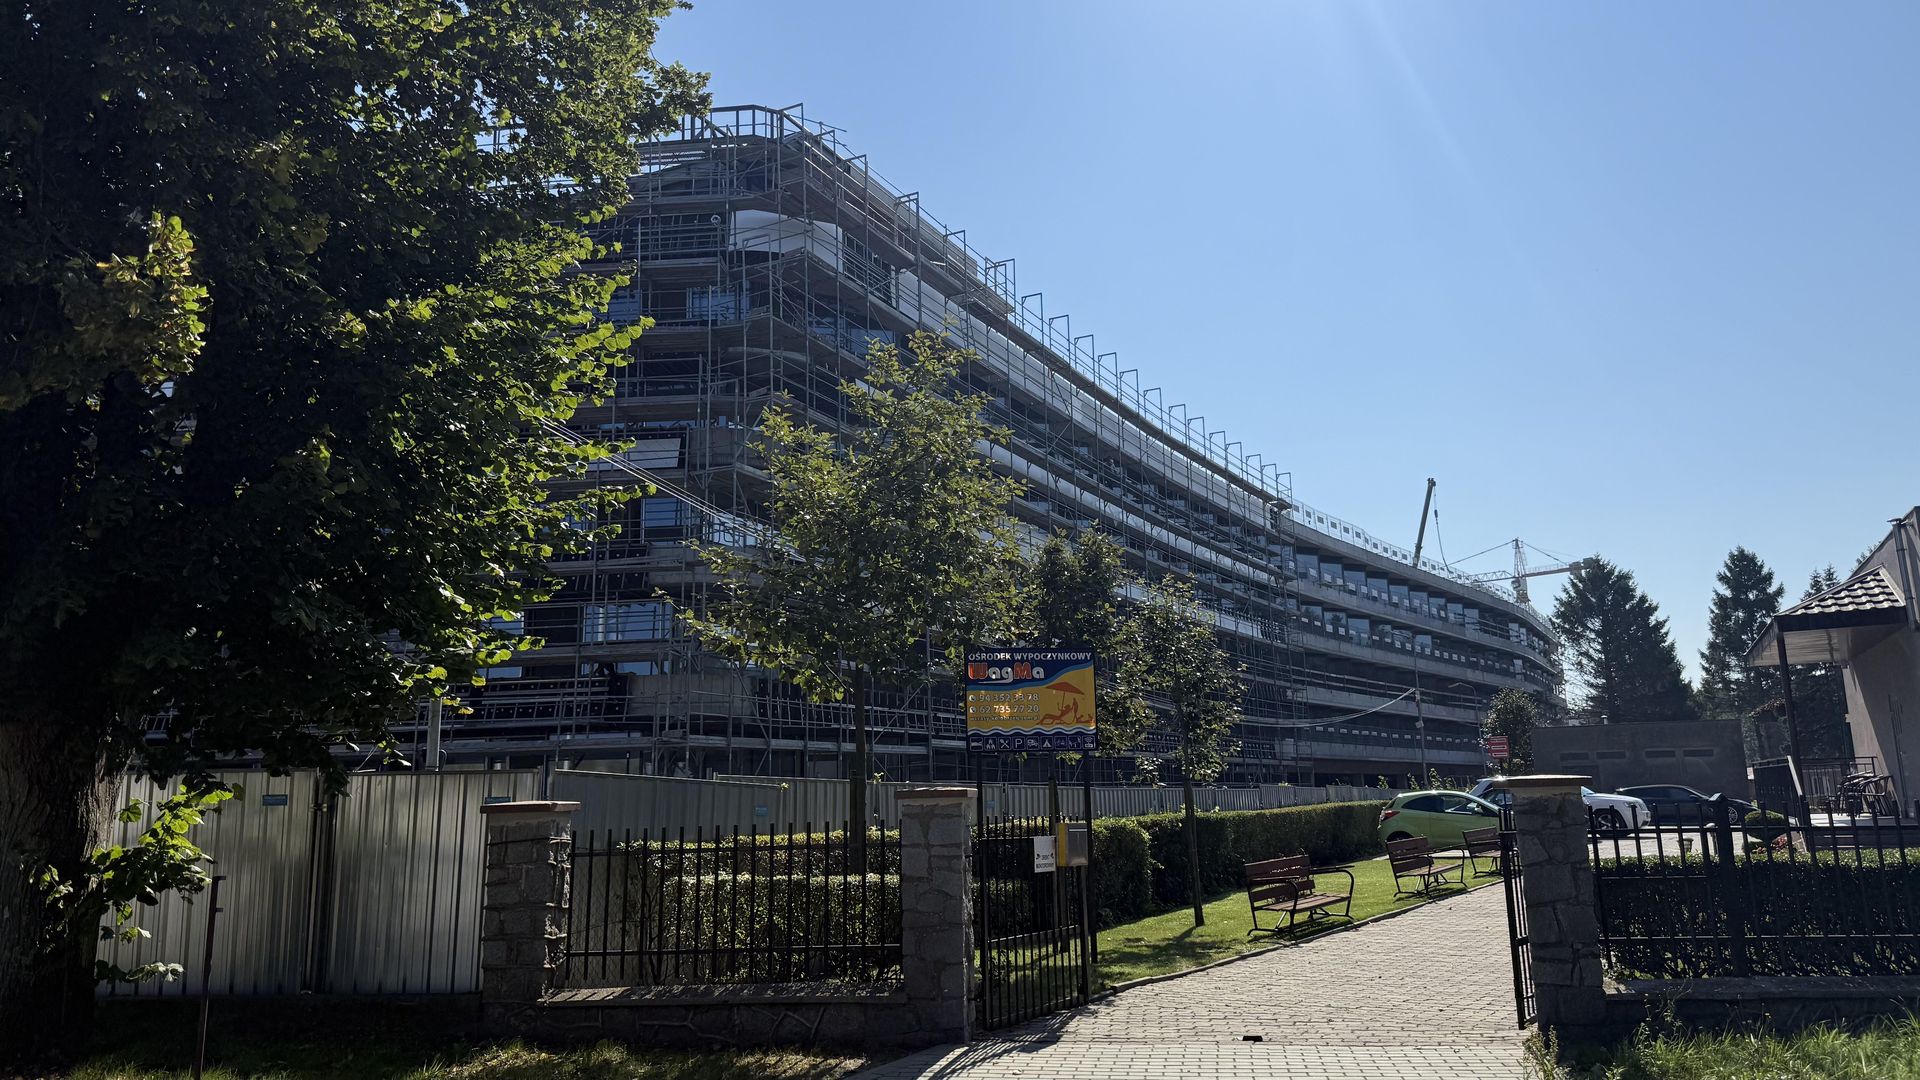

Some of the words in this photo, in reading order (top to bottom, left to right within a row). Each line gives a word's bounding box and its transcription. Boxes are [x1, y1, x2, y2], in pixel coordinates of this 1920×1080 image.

[968, 652, 1012, 660] OŚRODEK
[1013, 652, 1092, 660] WYPOCZYNKOWY
[968, 661, 1045, 684] WagMa
[993, 693, 1011, 702] 352
[1013, 692, 1025, 701] 33
[1027, 692, 1039, 701] 78
[993, 704, 1011, 713] 735
[1027, 704, 1039, 713] 20
[1015, 738, 1023, 749] P
